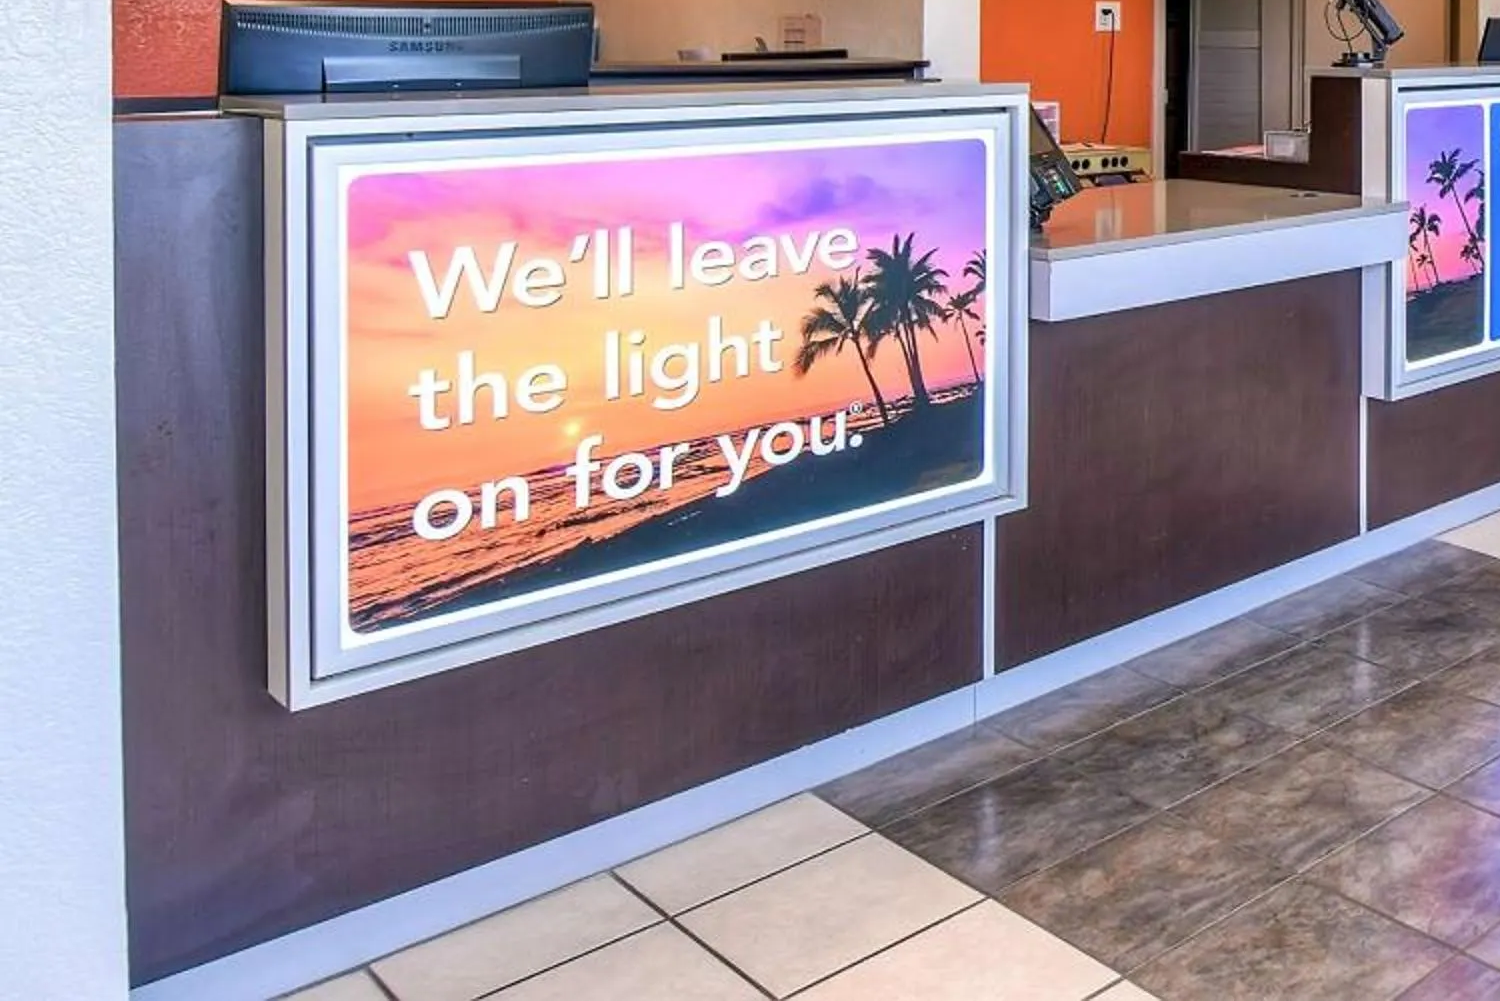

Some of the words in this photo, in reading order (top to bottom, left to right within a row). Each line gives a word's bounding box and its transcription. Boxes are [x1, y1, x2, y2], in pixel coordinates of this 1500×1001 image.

[409, 224, 634, 318] We'll
[670, 221, 859, 290] leave
[409, 350, 567, 431] the
[604, 316, 784, 410] light
[412, 475, 529, 541] on
[567, 435, 692, 510] for
